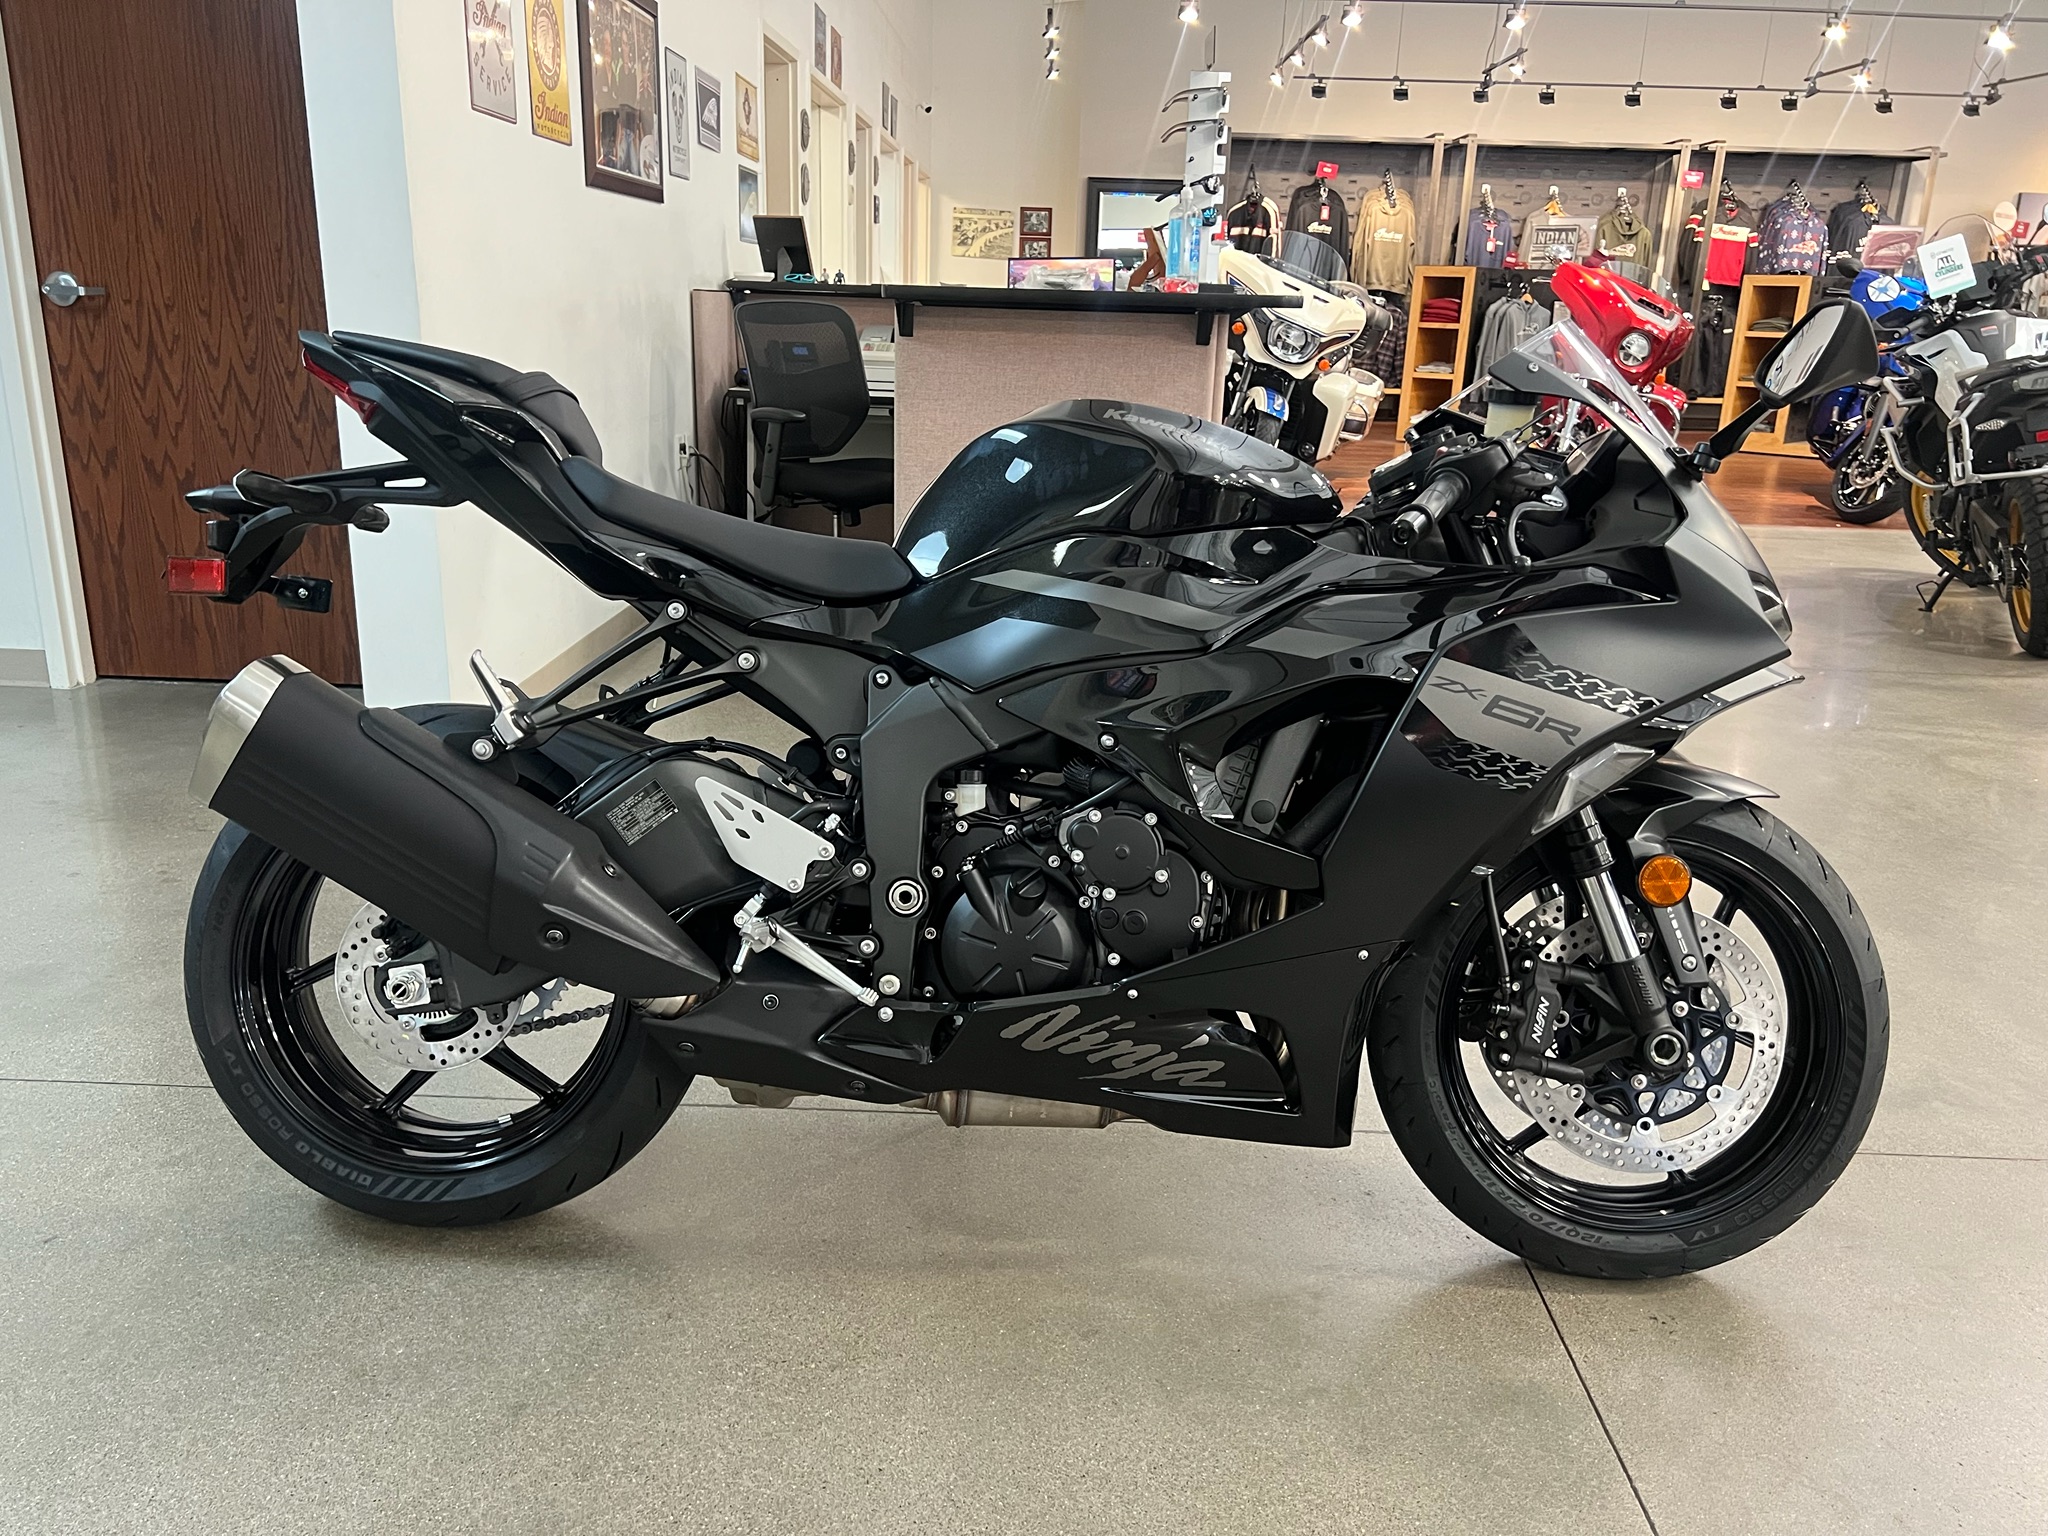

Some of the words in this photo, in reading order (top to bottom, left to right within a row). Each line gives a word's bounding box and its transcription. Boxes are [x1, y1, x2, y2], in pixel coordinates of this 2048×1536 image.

[473, 1, 506, 38] Indian
[473, 51, 512, 97] SERVICE
[535, 91, 569, 129] Indian
[1533, 230, 1577, 244] INDIAN
[1937, 254, 1956, 270] ALL
[1531, 996, 1550, 1044] NISSIN
[222, 1047, 245, 1077] IV
[1000, 1004, 1226, 1087] Ninja
[294, 1139, 374, 1189] DIABLO
[1733, 1173, 1804, 1227] ROSSO
[1688, 1223, 1722, 1243] IV
